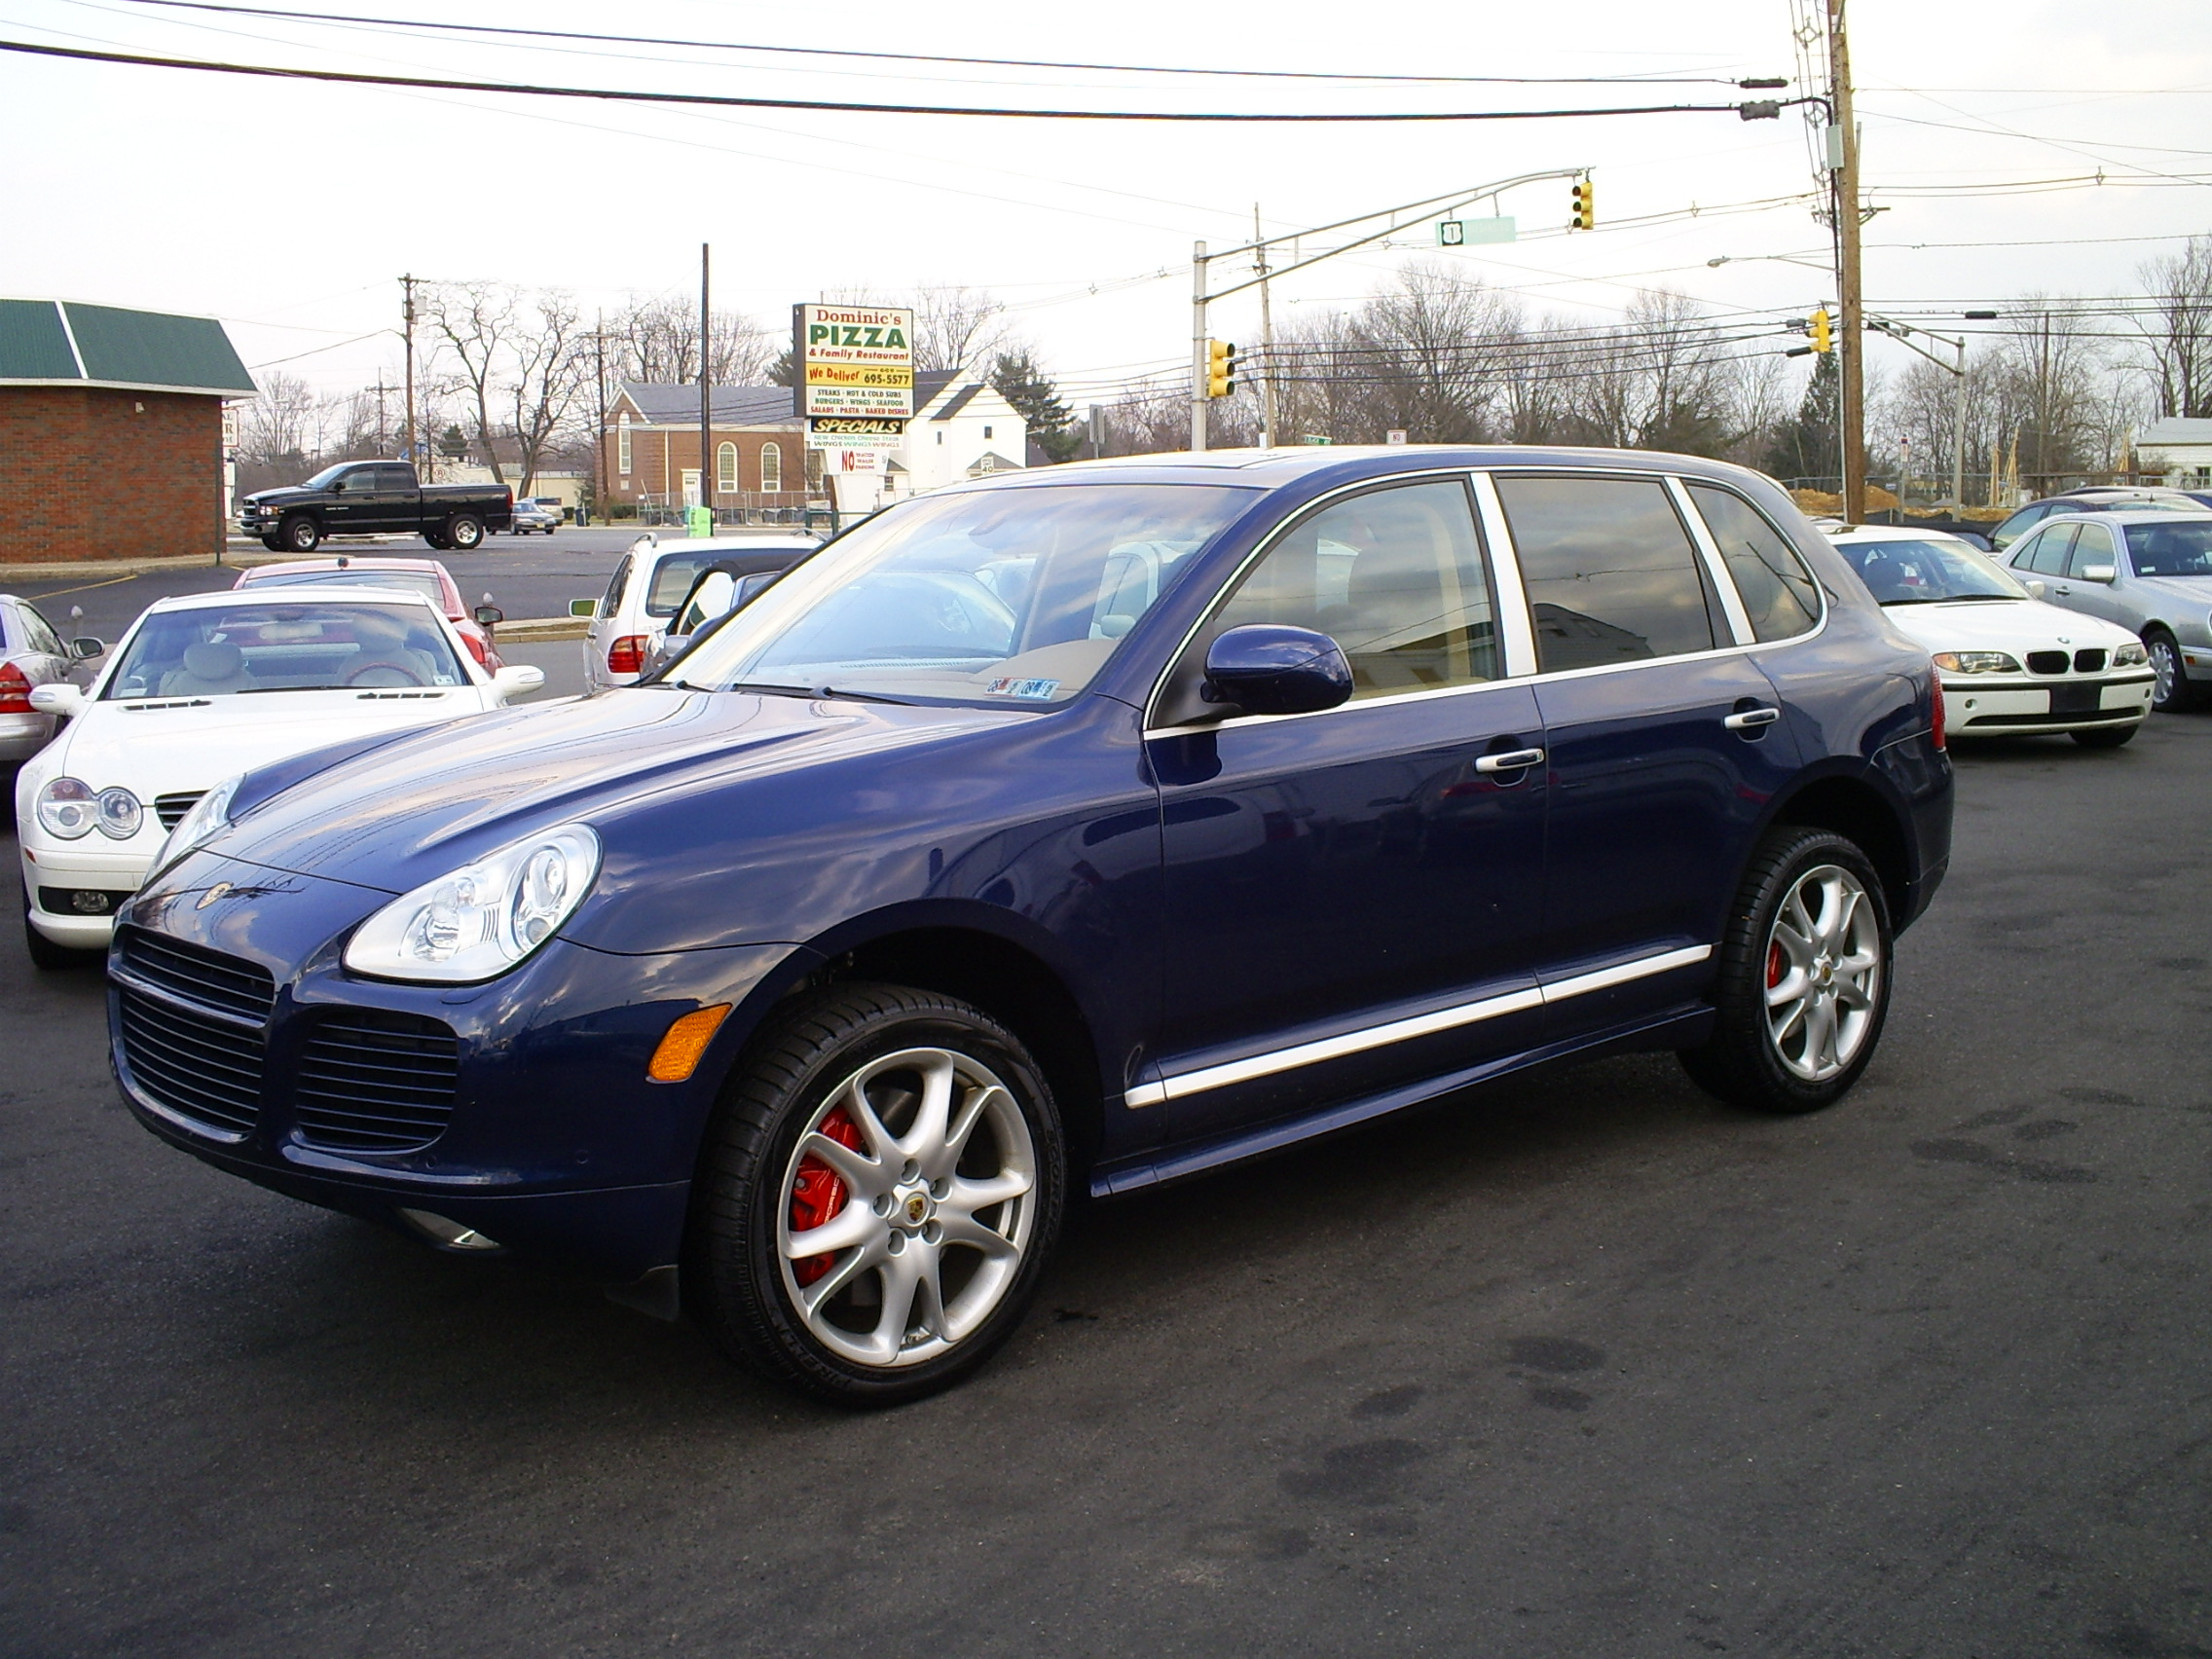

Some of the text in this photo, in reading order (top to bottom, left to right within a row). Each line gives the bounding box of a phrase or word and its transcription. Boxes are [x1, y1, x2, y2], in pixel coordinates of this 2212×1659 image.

[816, 309, 902, 325] Dominic's
[810, 324, 907, 350] PIZZA
[809, 349, 909, 361] & Family Restaurant
[809, 367, 861, 383] We Deliver
[865, 407, 887, 416] BAKED
[814, 419, 901, 434] SPECIALS
[841, 450, 855, 472] NO
[824, 1174, 840, 1224] PORSC
